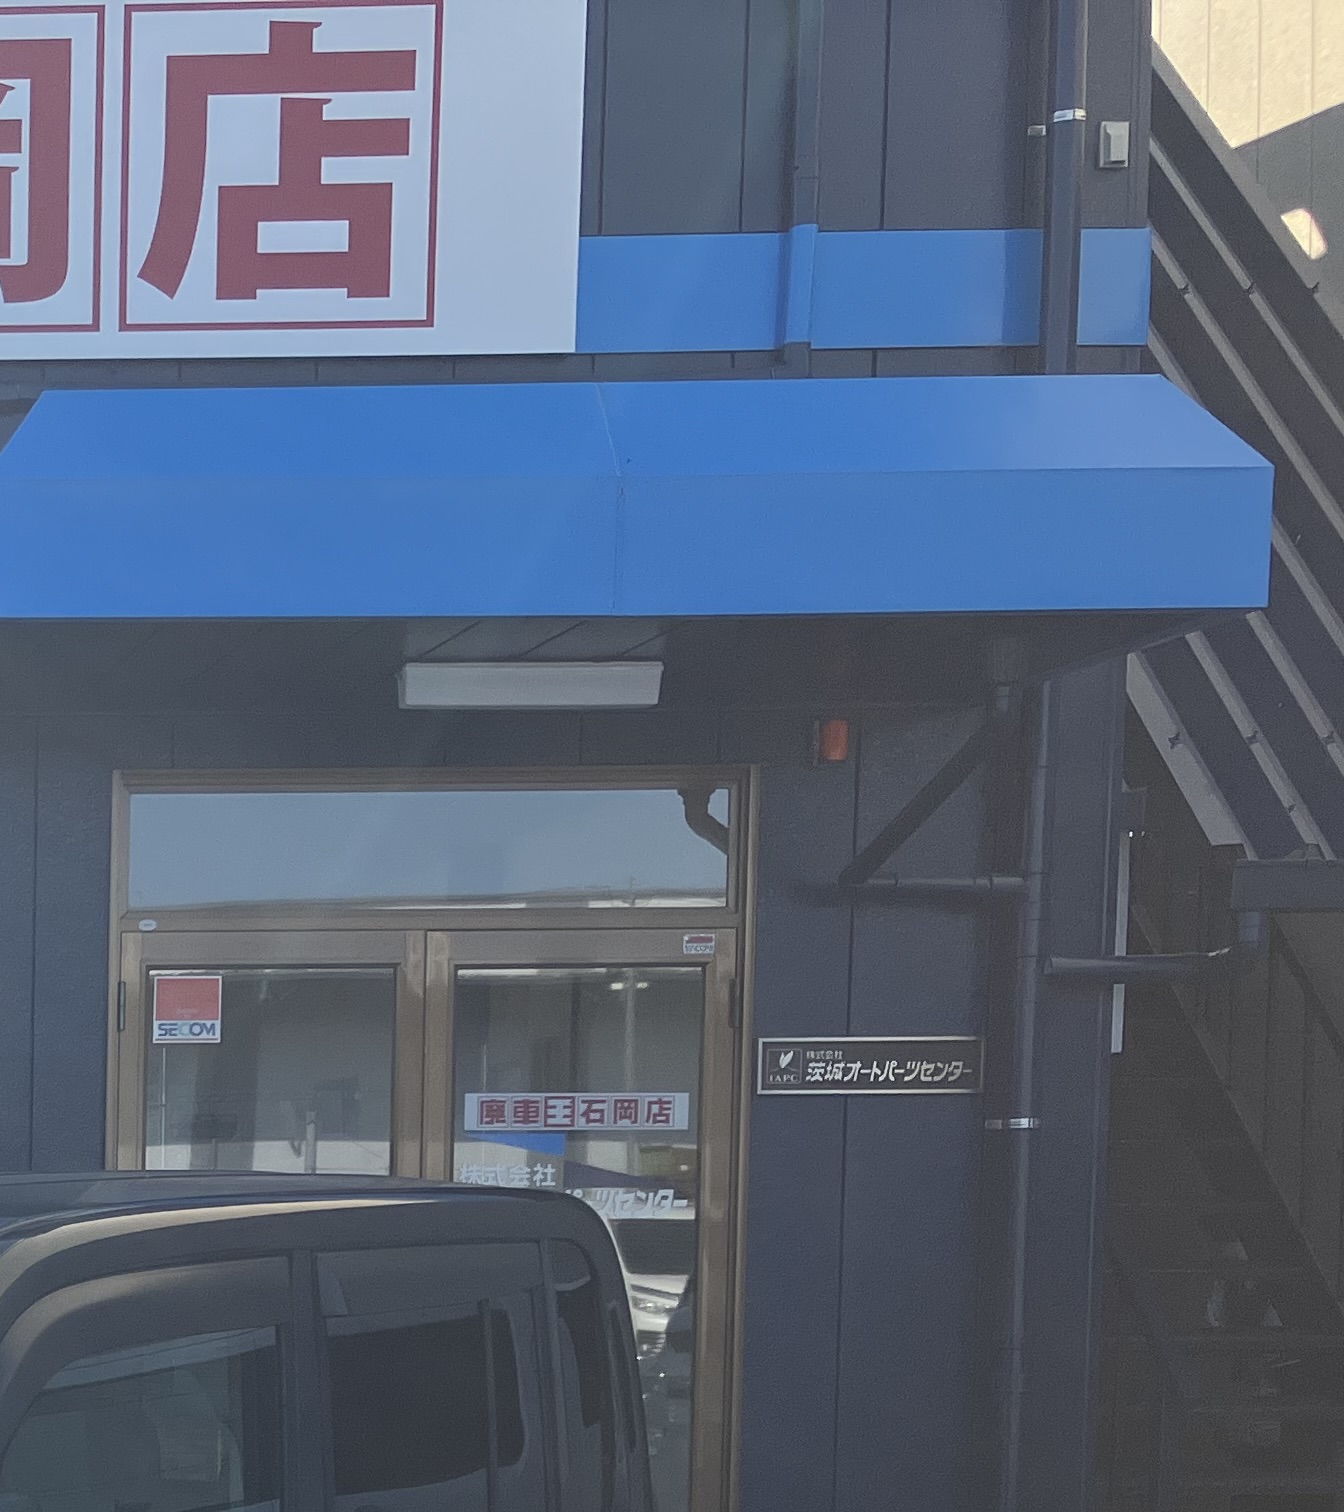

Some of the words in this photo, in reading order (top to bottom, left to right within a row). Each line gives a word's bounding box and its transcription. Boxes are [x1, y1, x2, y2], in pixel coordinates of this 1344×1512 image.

[157, 1022, 216, 1037] SECOM
[806, 1050, 844, 1060] 株式会社
[769, 1074, 800, 1083] IAPC
[805, 1060, 973, 1082] 茨城オートパーツセンター
[479, 1095, 673, 1128] 廃車王石岡店
[460, 1163, 557, 1187] 株式会社
